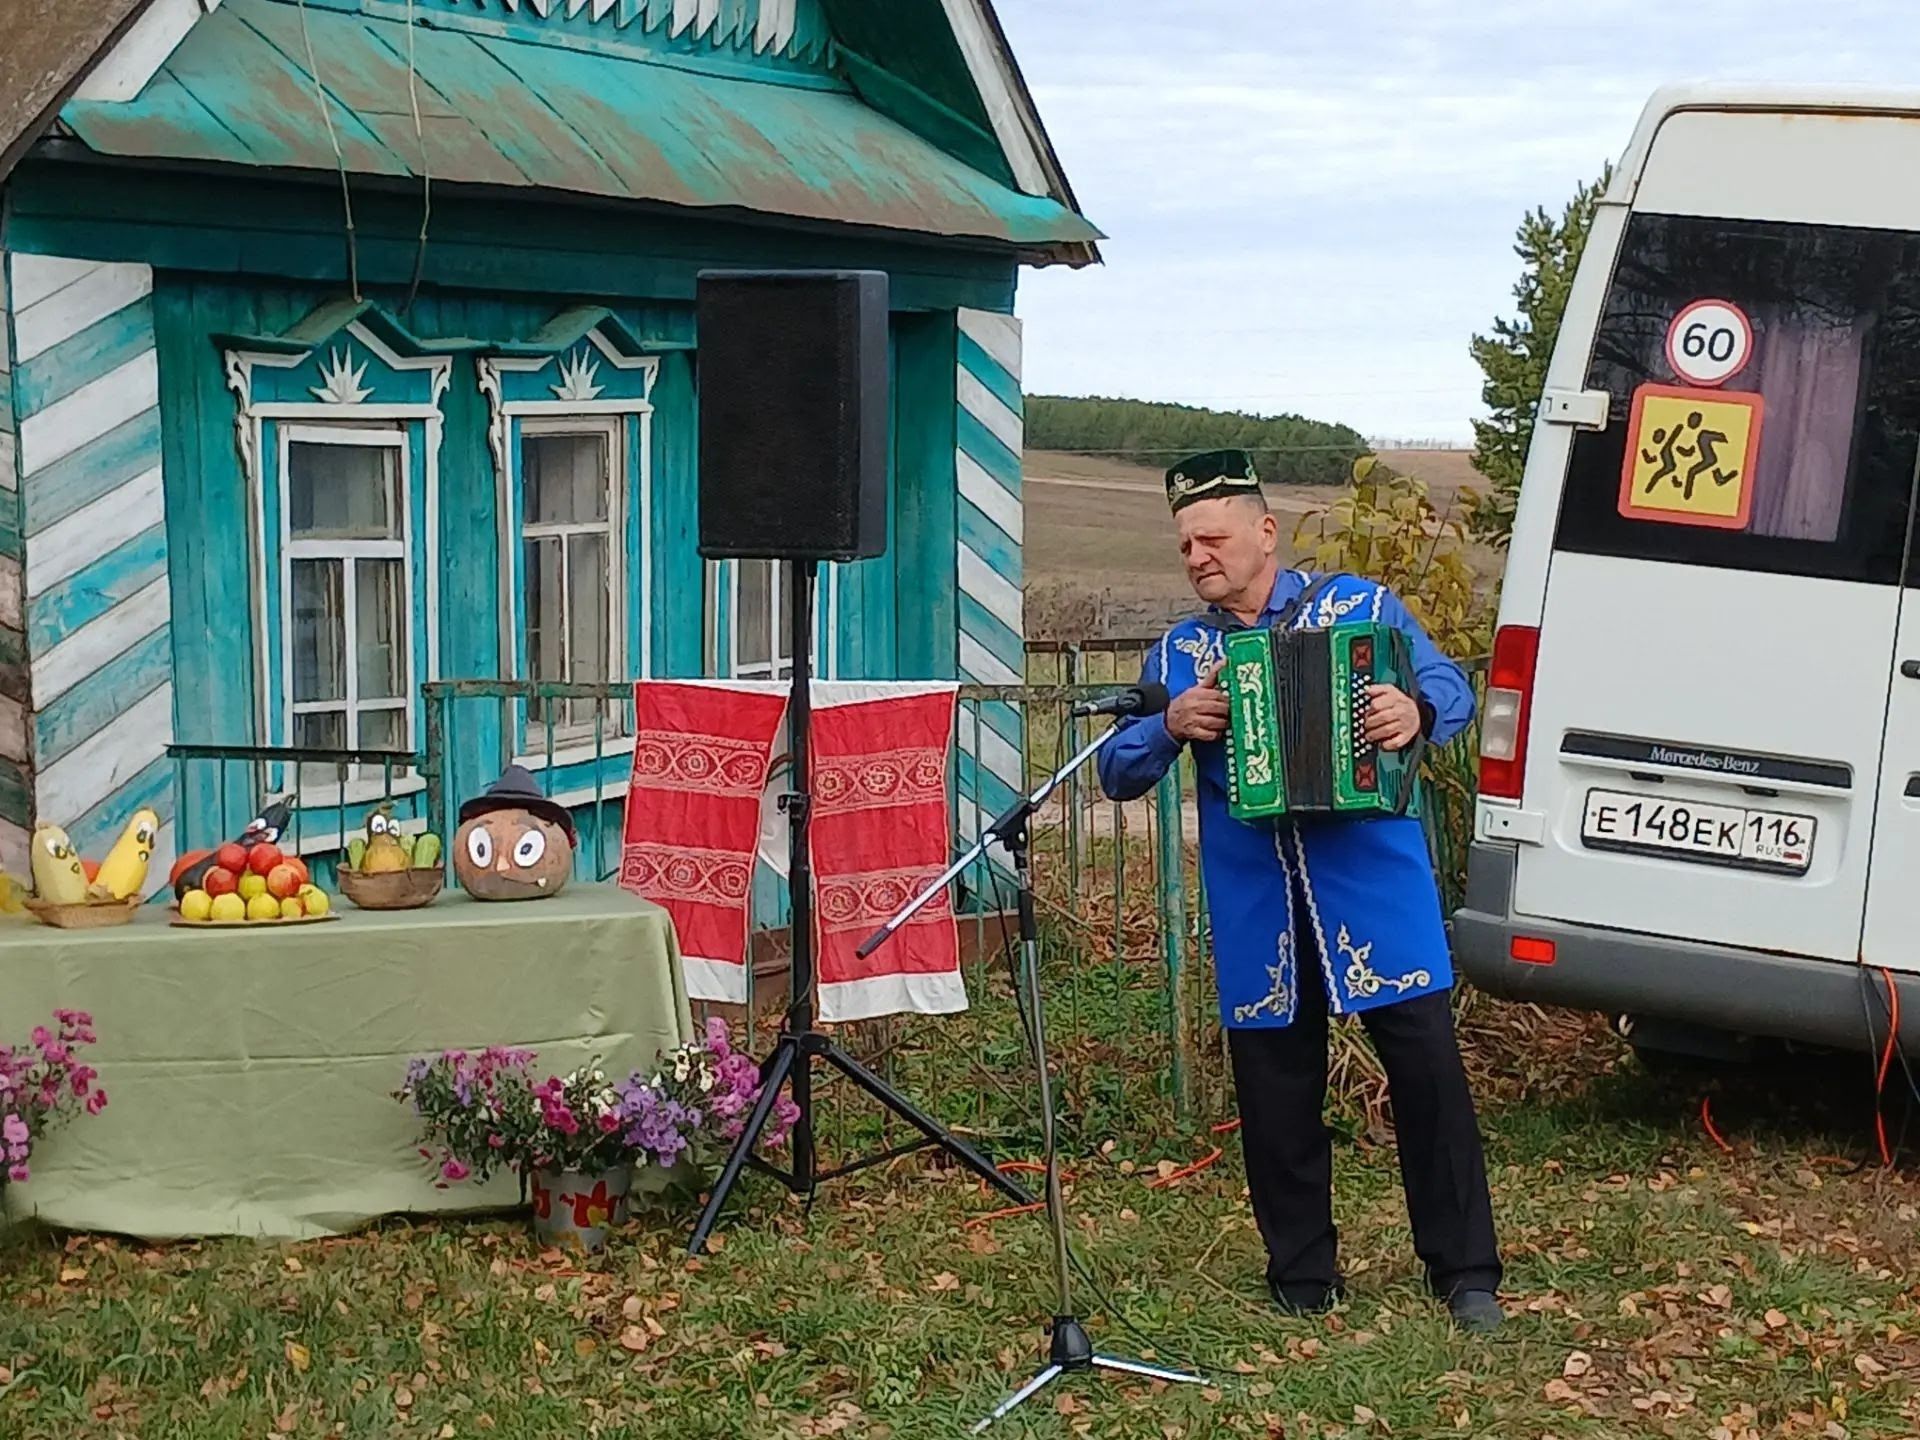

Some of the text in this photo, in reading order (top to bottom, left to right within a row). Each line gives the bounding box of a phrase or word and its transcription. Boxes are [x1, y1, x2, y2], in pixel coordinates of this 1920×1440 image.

[1682, 323, 1735, 361] 60
[1650, 746, 1760, 774] Mercedes-Benz
[1748, 816, 1800, 847] 116
[1756, 844, 1782, 857] RUS
